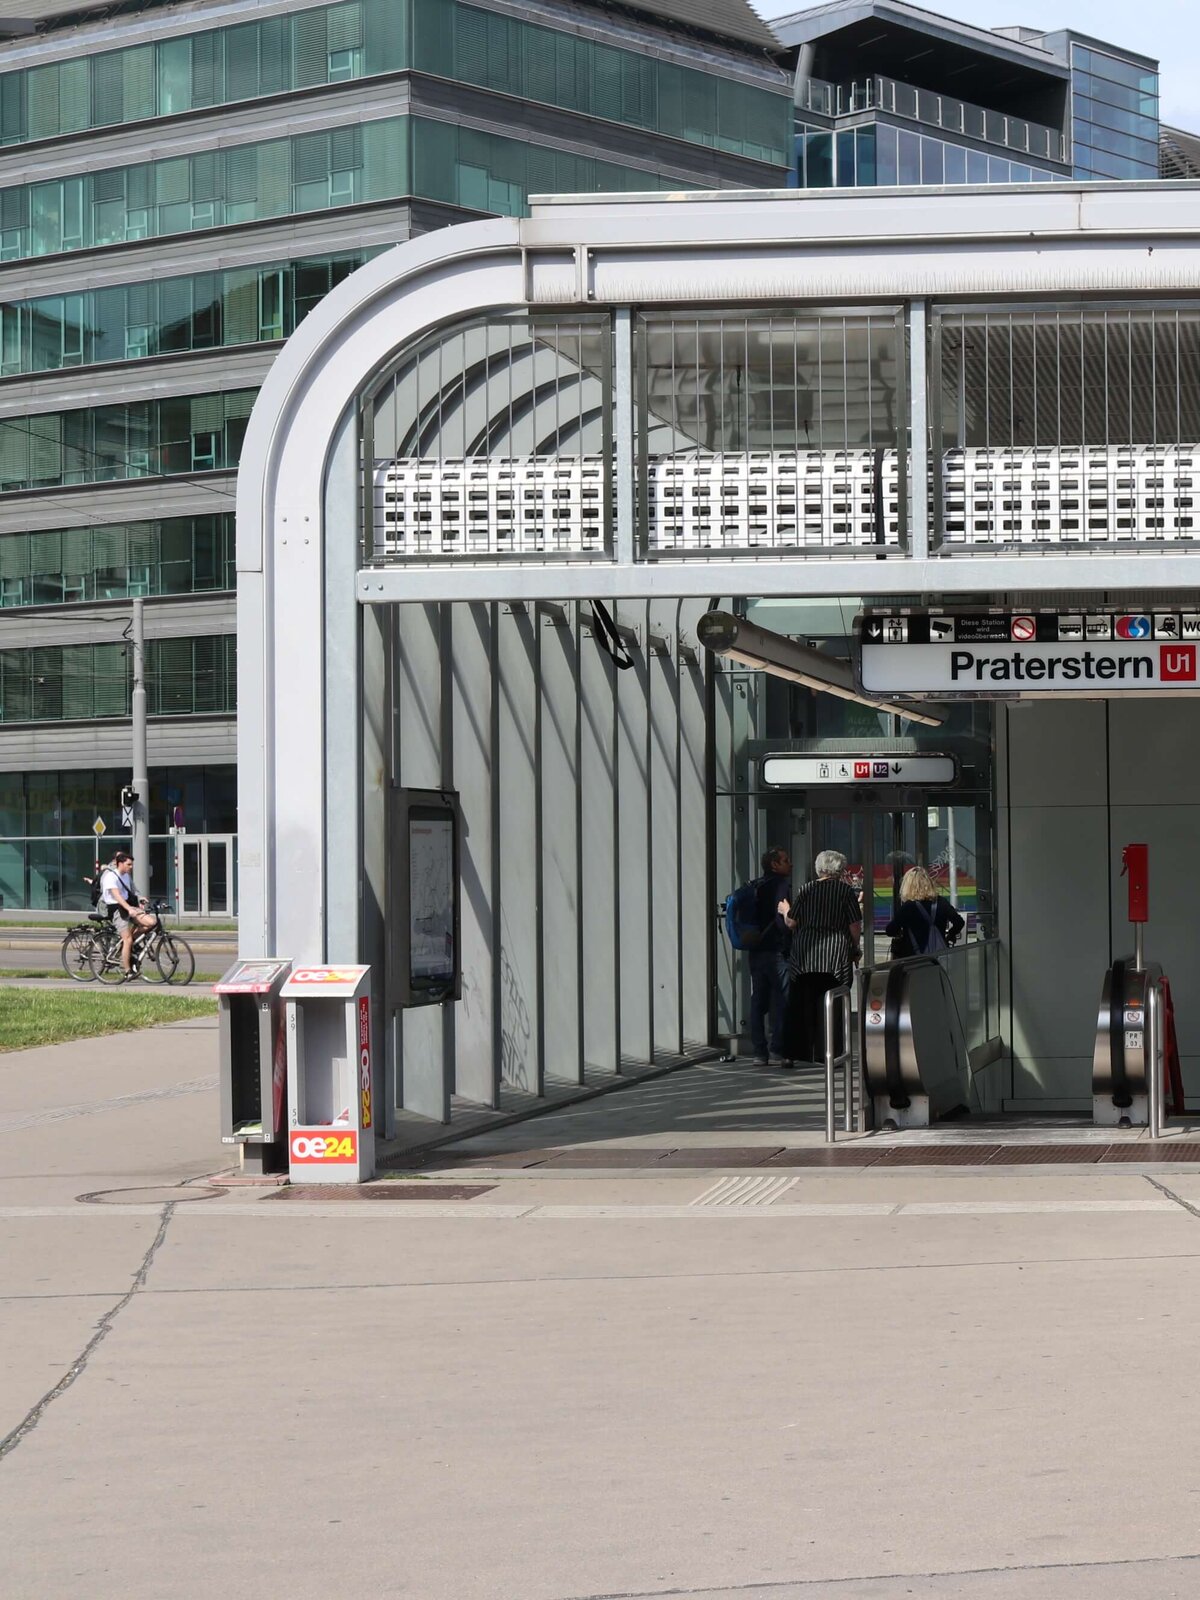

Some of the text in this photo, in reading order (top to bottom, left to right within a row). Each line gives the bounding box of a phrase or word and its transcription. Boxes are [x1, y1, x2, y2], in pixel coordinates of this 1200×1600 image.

[951, 651, 1153, 680] Praterstern
[1166, 653, 1190, 673] U1
[856, 765, 888, 774] U1 U2
